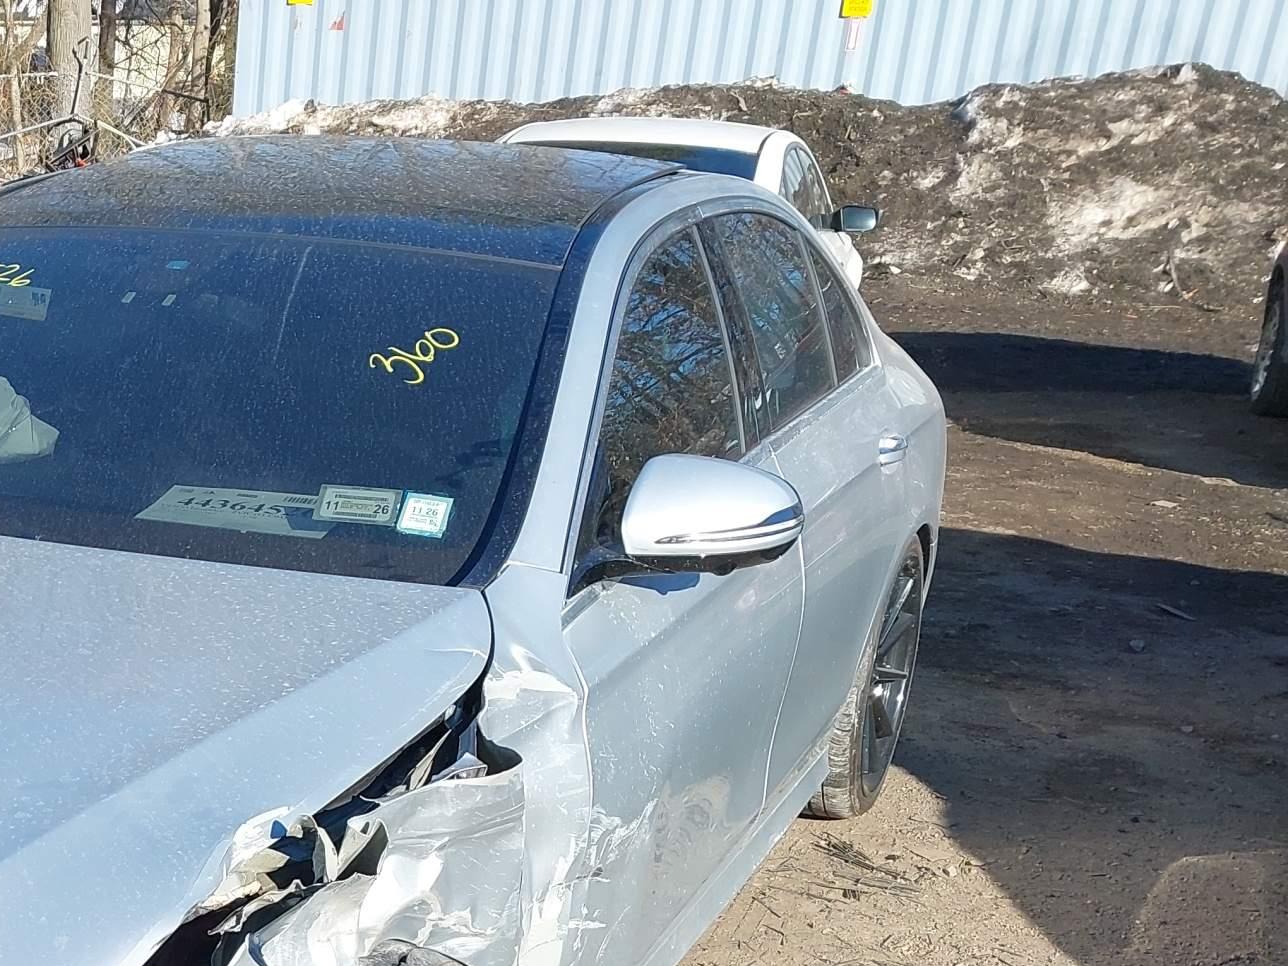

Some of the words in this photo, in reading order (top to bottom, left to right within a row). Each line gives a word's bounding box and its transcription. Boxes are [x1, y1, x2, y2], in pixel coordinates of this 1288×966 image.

[369, 327, 460, 385] 360
[325, 500, 340, 511] 11
[372, 503, 391, 515] 26
